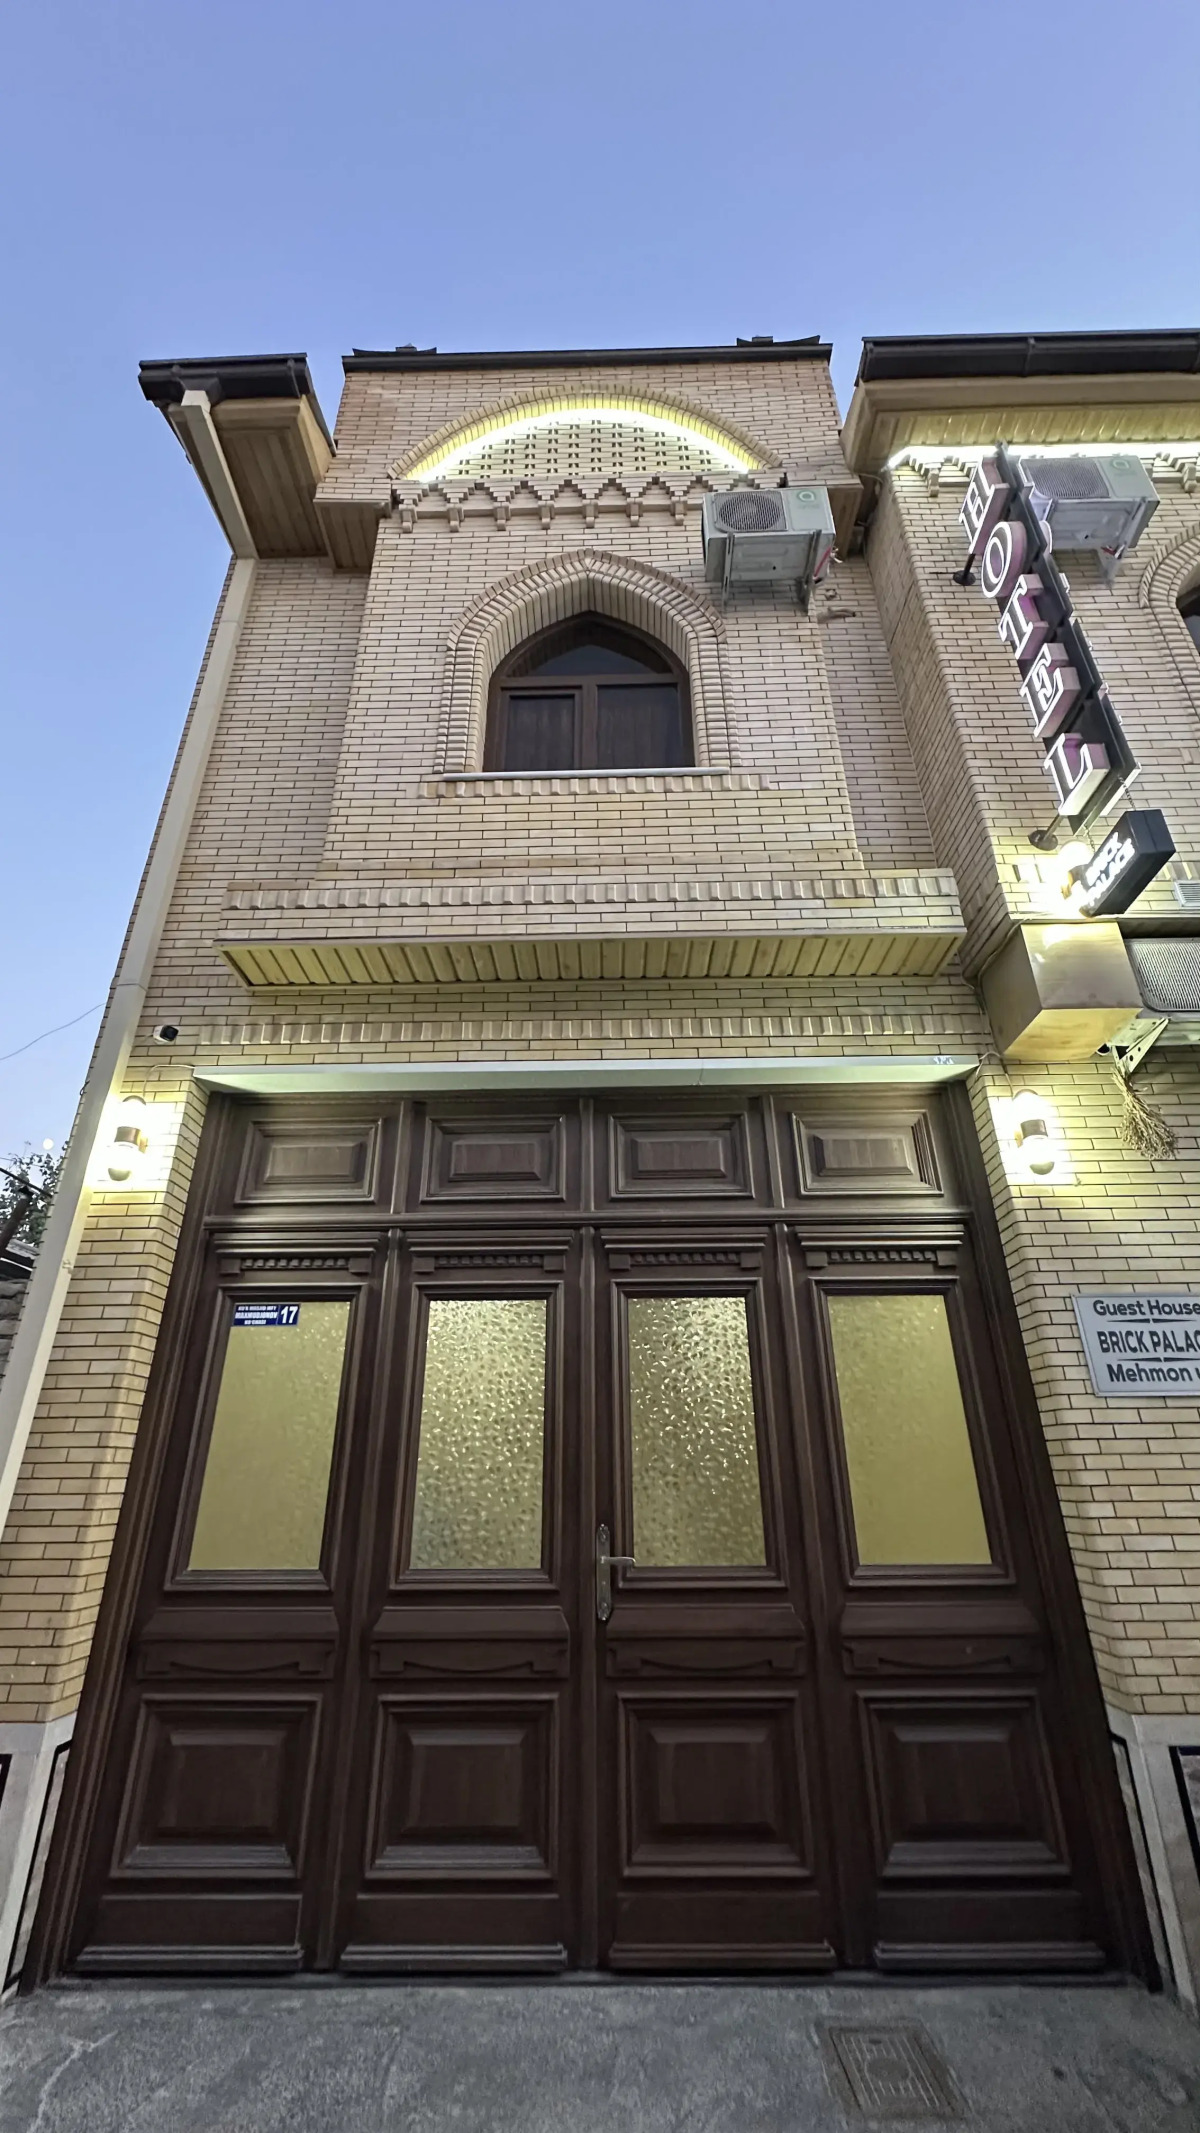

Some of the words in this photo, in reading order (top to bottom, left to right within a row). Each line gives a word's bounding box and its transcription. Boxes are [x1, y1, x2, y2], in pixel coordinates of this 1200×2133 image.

[959, 456, 1100, 816] HOTEL
[280, 1306, 298, 1324] 17
[1093, 1300, 1146, 1316] Guest
[1147, 1299, 1200, 1316] House
[1097, 1330, 1149, 1353] BRICK
[1106, 1363, 1193, 1382] Mehmon
